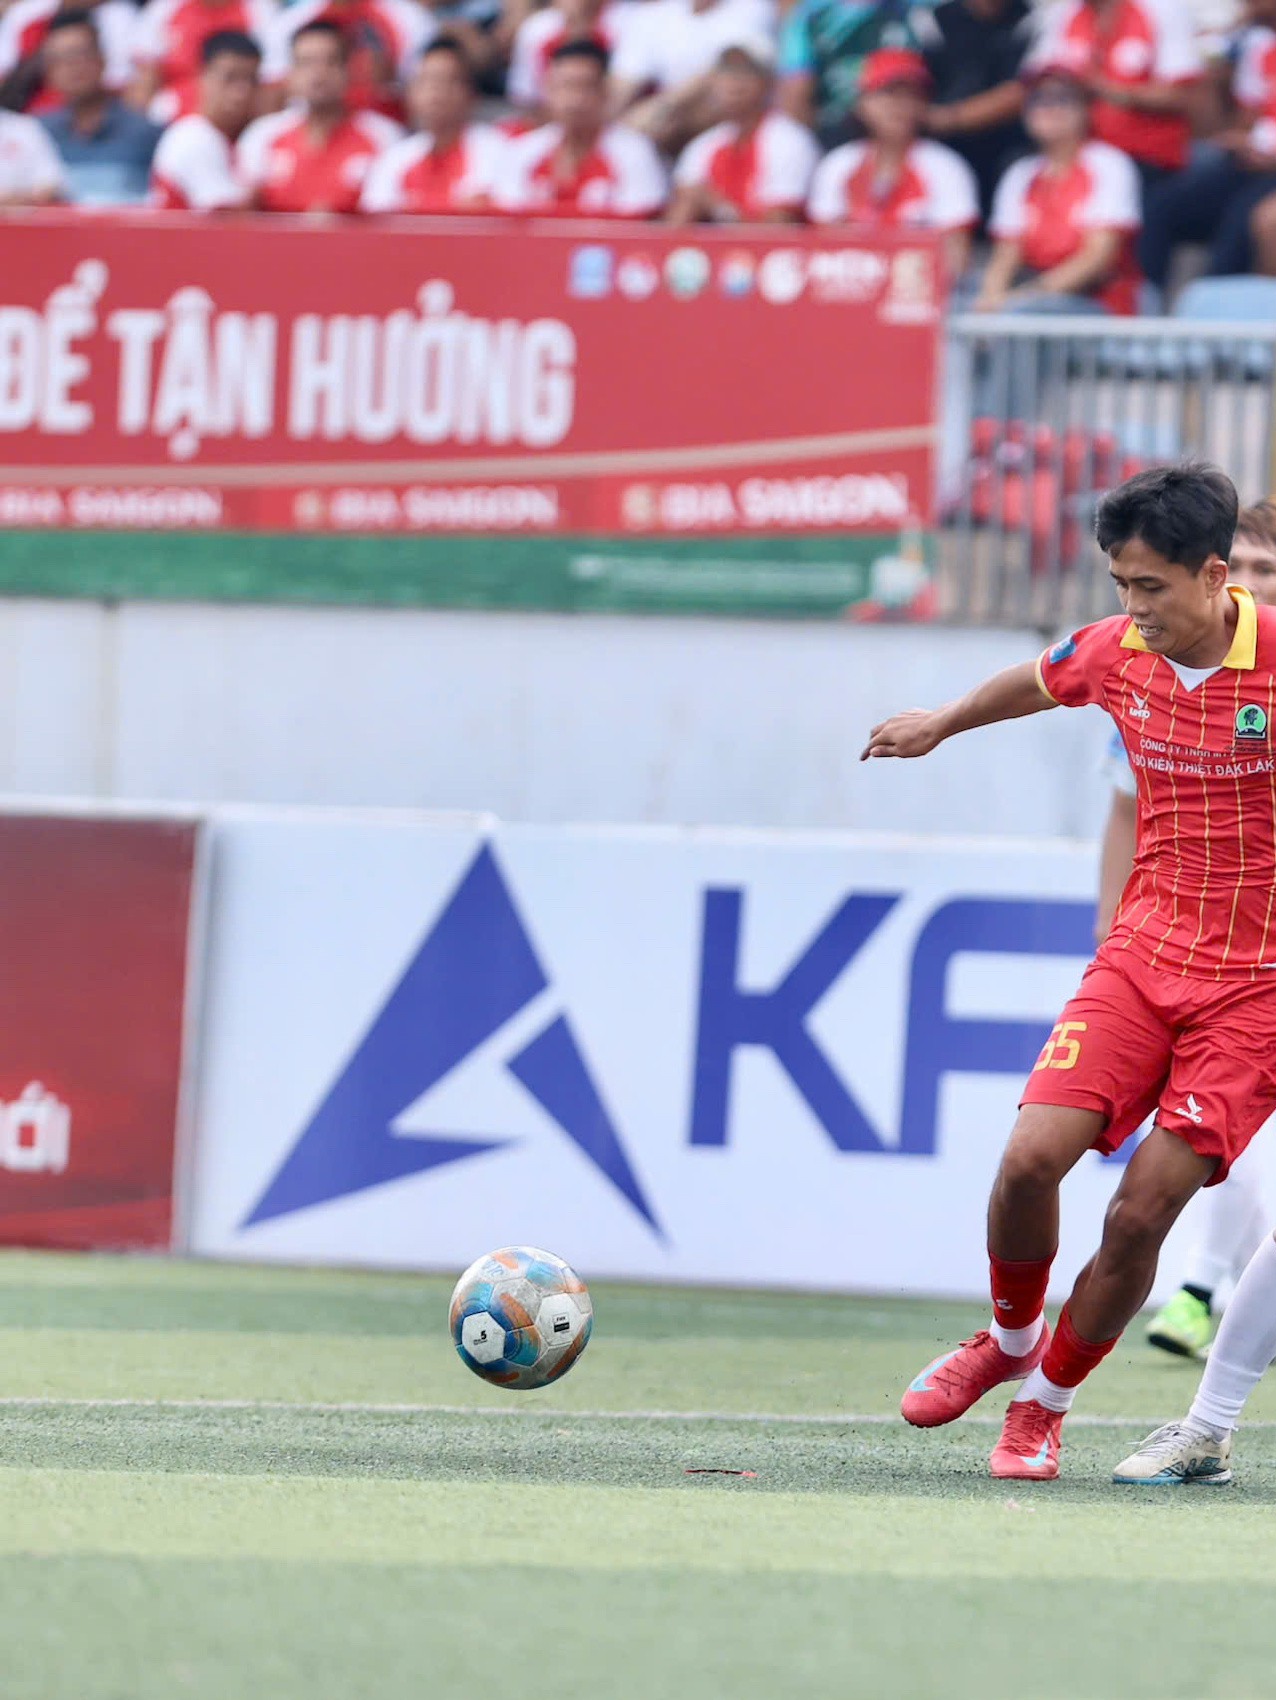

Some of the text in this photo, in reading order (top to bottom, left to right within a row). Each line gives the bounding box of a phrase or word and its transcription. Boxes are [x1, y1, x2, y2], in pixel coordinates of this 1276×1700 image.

[106, 286, 278, 461] TẬN
[288, 278, 577, 447] HƯỞNG
[403, 485, 558, 528] SAIGON
[738, 472, 908, 528] SAIGON
[480, 1330, 487, 1340] 5
